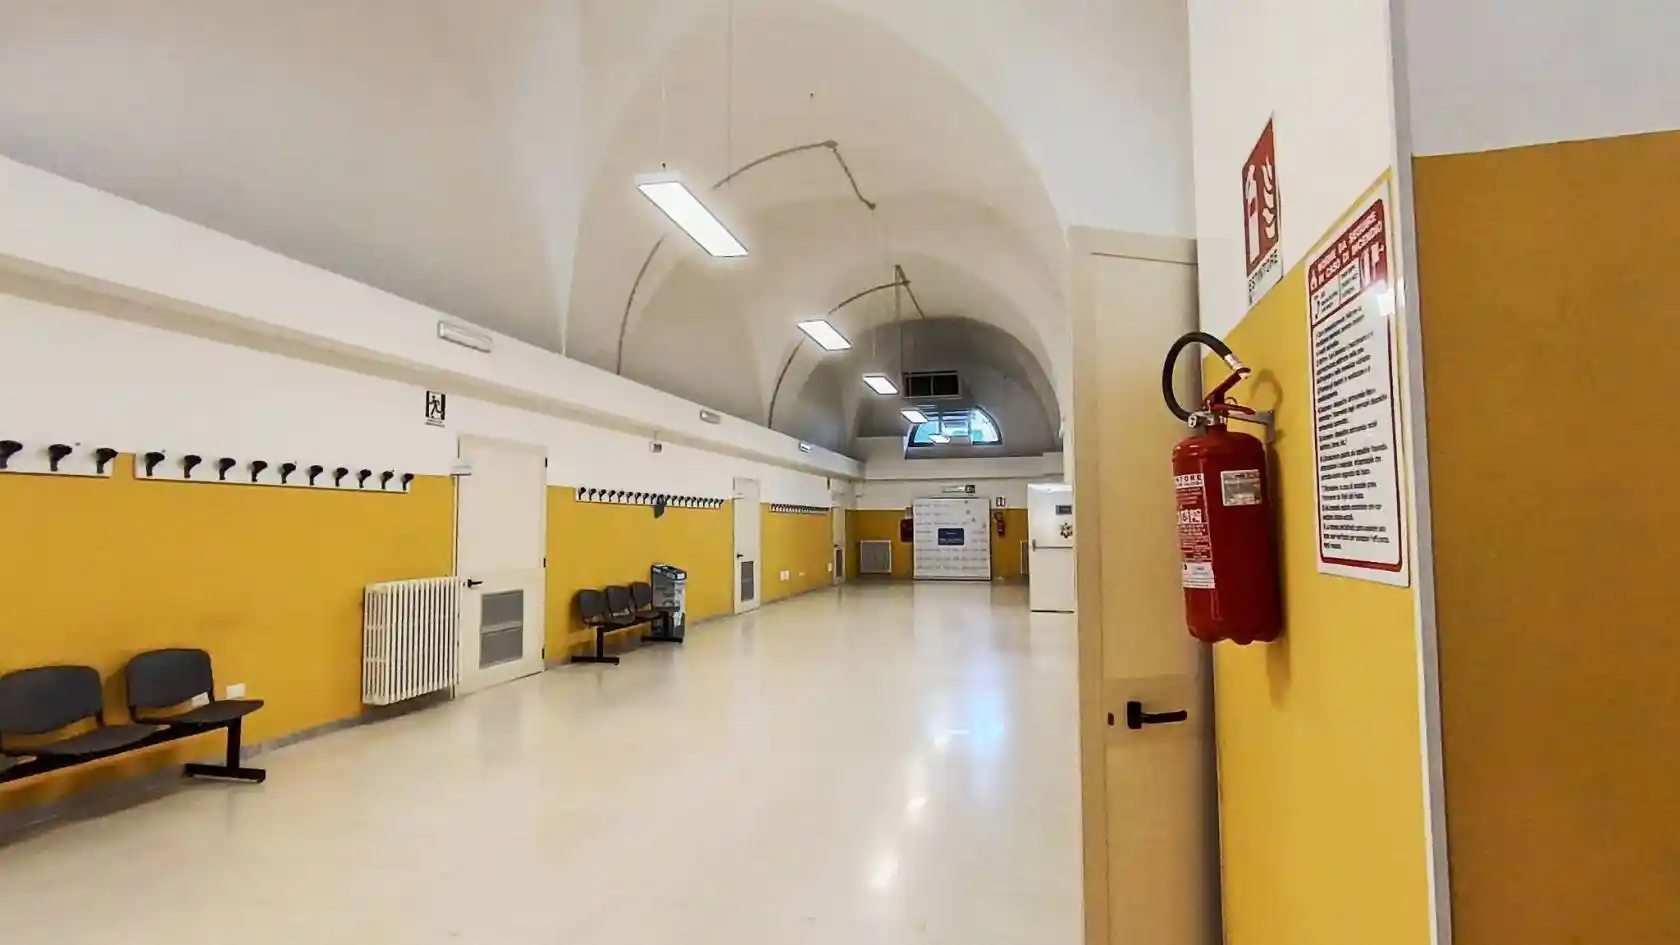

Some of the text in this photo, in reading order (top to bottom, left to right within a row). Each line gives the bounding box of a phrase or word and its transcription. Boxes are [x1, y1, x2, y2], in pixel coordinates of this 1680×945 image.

[1248, 248, 1278, 292] ESTINTORE
[1325, 258, 1341, 278] CASO
[1351, 220, 1383, 257] INCENDIO
